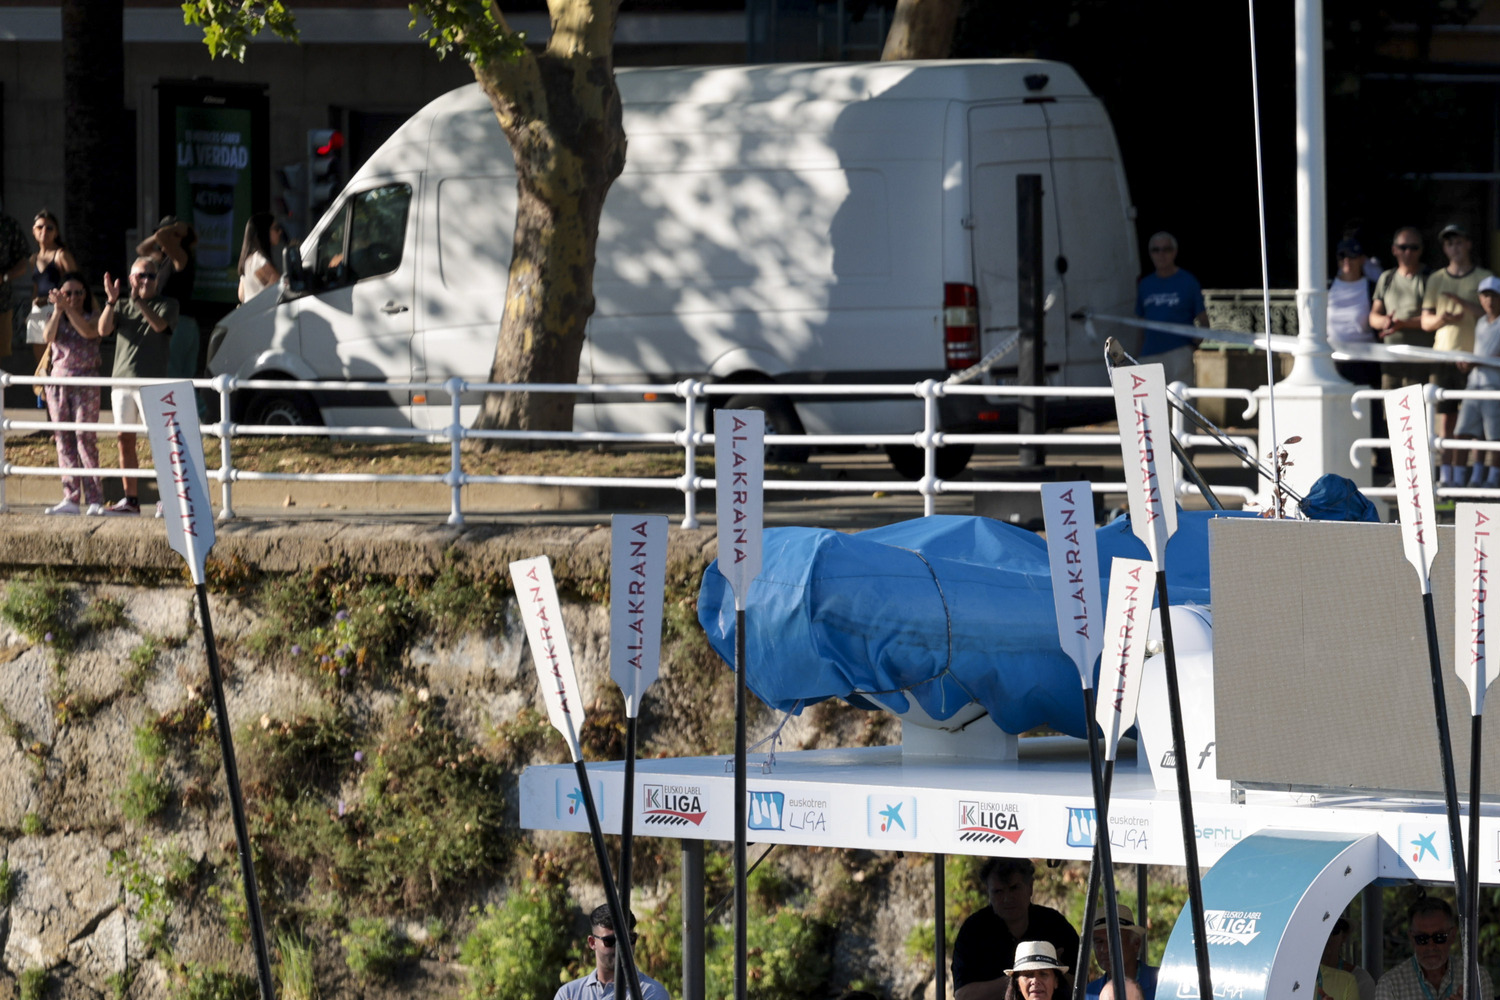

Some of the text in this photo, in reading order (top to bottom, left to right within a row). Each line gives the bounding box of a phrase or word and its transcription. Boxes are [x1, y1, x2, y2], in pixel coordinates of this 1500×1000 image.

[177, 145, 248, 169] LA VERDAD
[162, 391, 199, 538] ALAKRANA
[732, 415, 748, 564] ALAKRANA
[1130, 373, 1160, 525] ALAKRANA
[1398, 394, 1426, 546] ALAKRANA
[630, 520, 648, 670] ALAKRANA
[1055, 488, 1090, 640] ALAKRANA
[1470, 510, 1490, 666] ALAKRANA
[528, 565, 571, 715] ALAKRANA
[1112, 566, 1143, 713] ALAKRANA
[664, 794, 702, 813] LIGA
[789, 798, 827, 809] euskotren
[789, 810, 826, 833] LIGA
[981, 812, 1019, 831] LIGA
[1110, 815, 1149, 827] euskotren
[1219, 918, 1257, 935] LIGA
